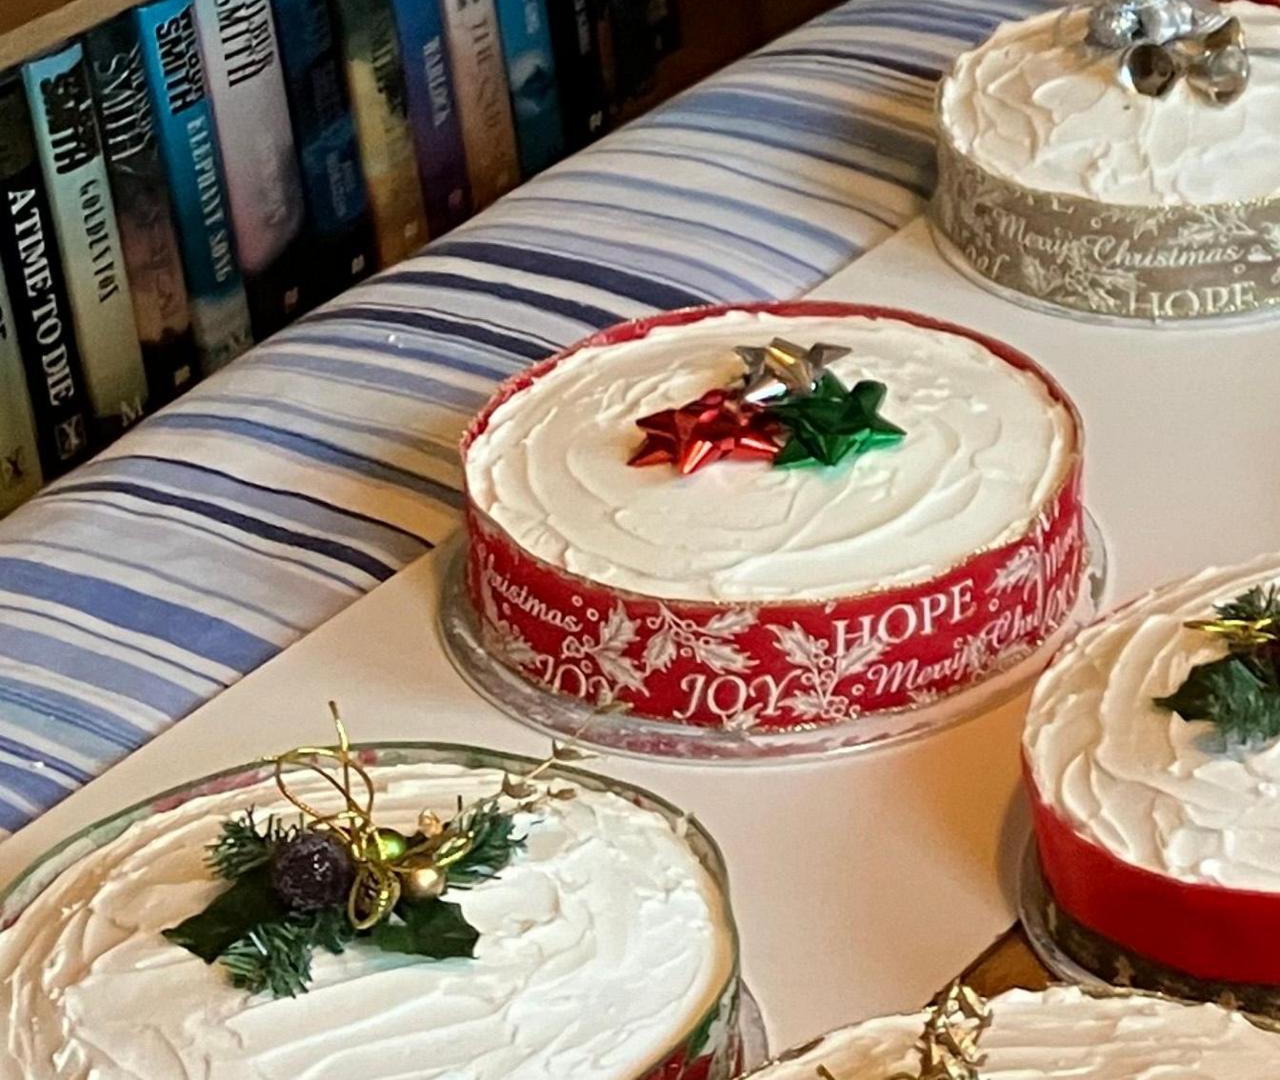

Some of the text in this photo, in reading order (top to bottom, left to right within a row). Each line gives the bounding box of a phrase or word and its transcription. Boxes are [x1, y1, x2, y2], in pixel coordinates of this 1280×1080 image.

[156, 20, 195, 114] SMITH
[423, 35, 450, 126] WARLOCK
[187, 119, 234, 282] ELEPHANT SONG
[8, 188, 75, 406] A TIME TO DIE
[1080, 235, 1246, 268] Christmas
[831, 578, 977, 657] HOPE
[672, 670, 802, 721] JOY
